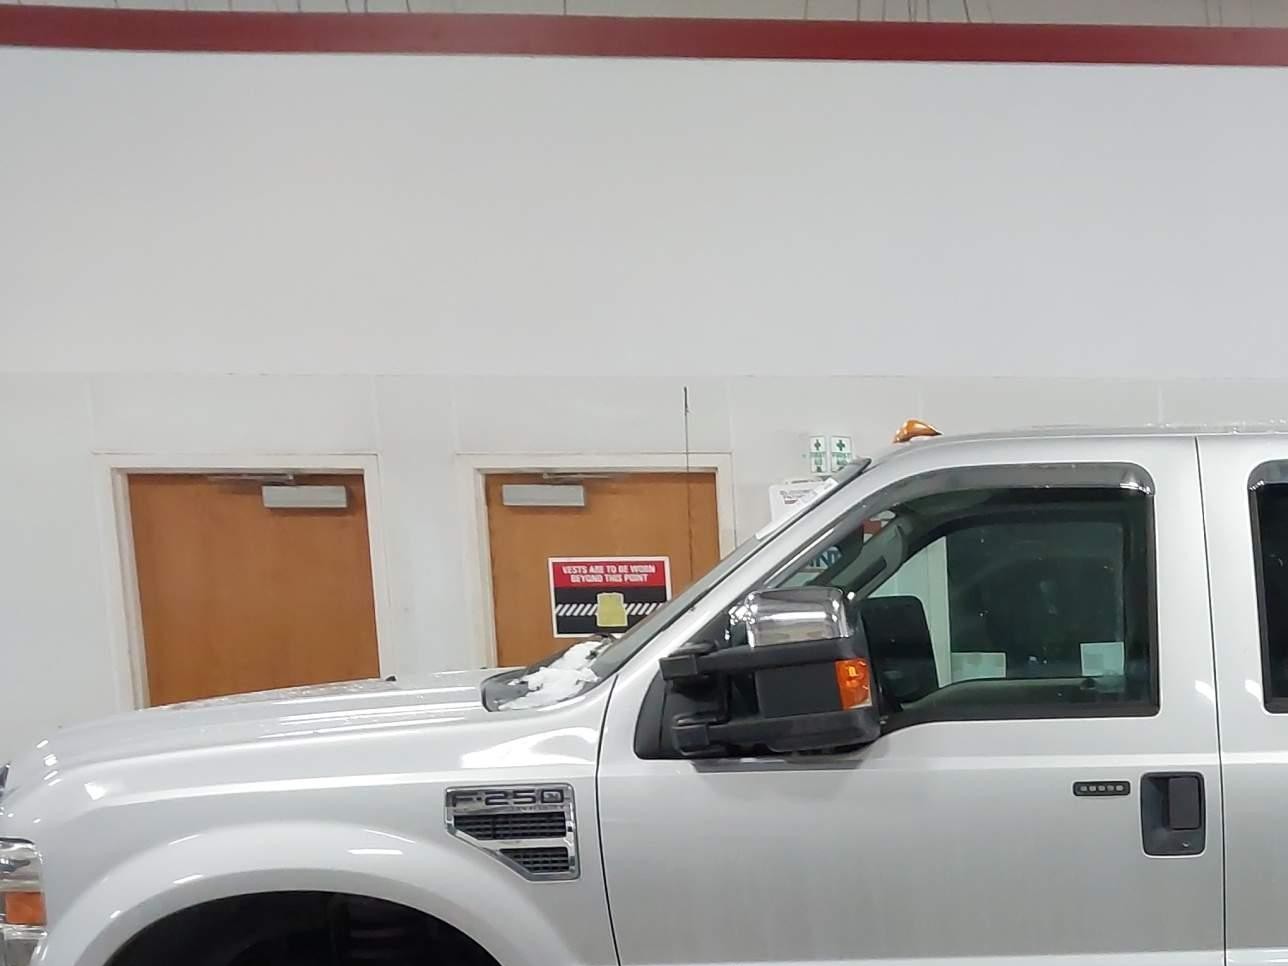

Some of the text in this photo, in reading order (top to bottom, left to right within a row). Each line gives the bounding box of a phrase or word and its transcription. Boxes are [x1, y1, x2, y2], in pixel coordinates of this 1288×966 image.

[562, 564, 656, 574] VESTS ARE TO BE WORN
[571, 573, 648, 583] BEYOND THIS POINT
